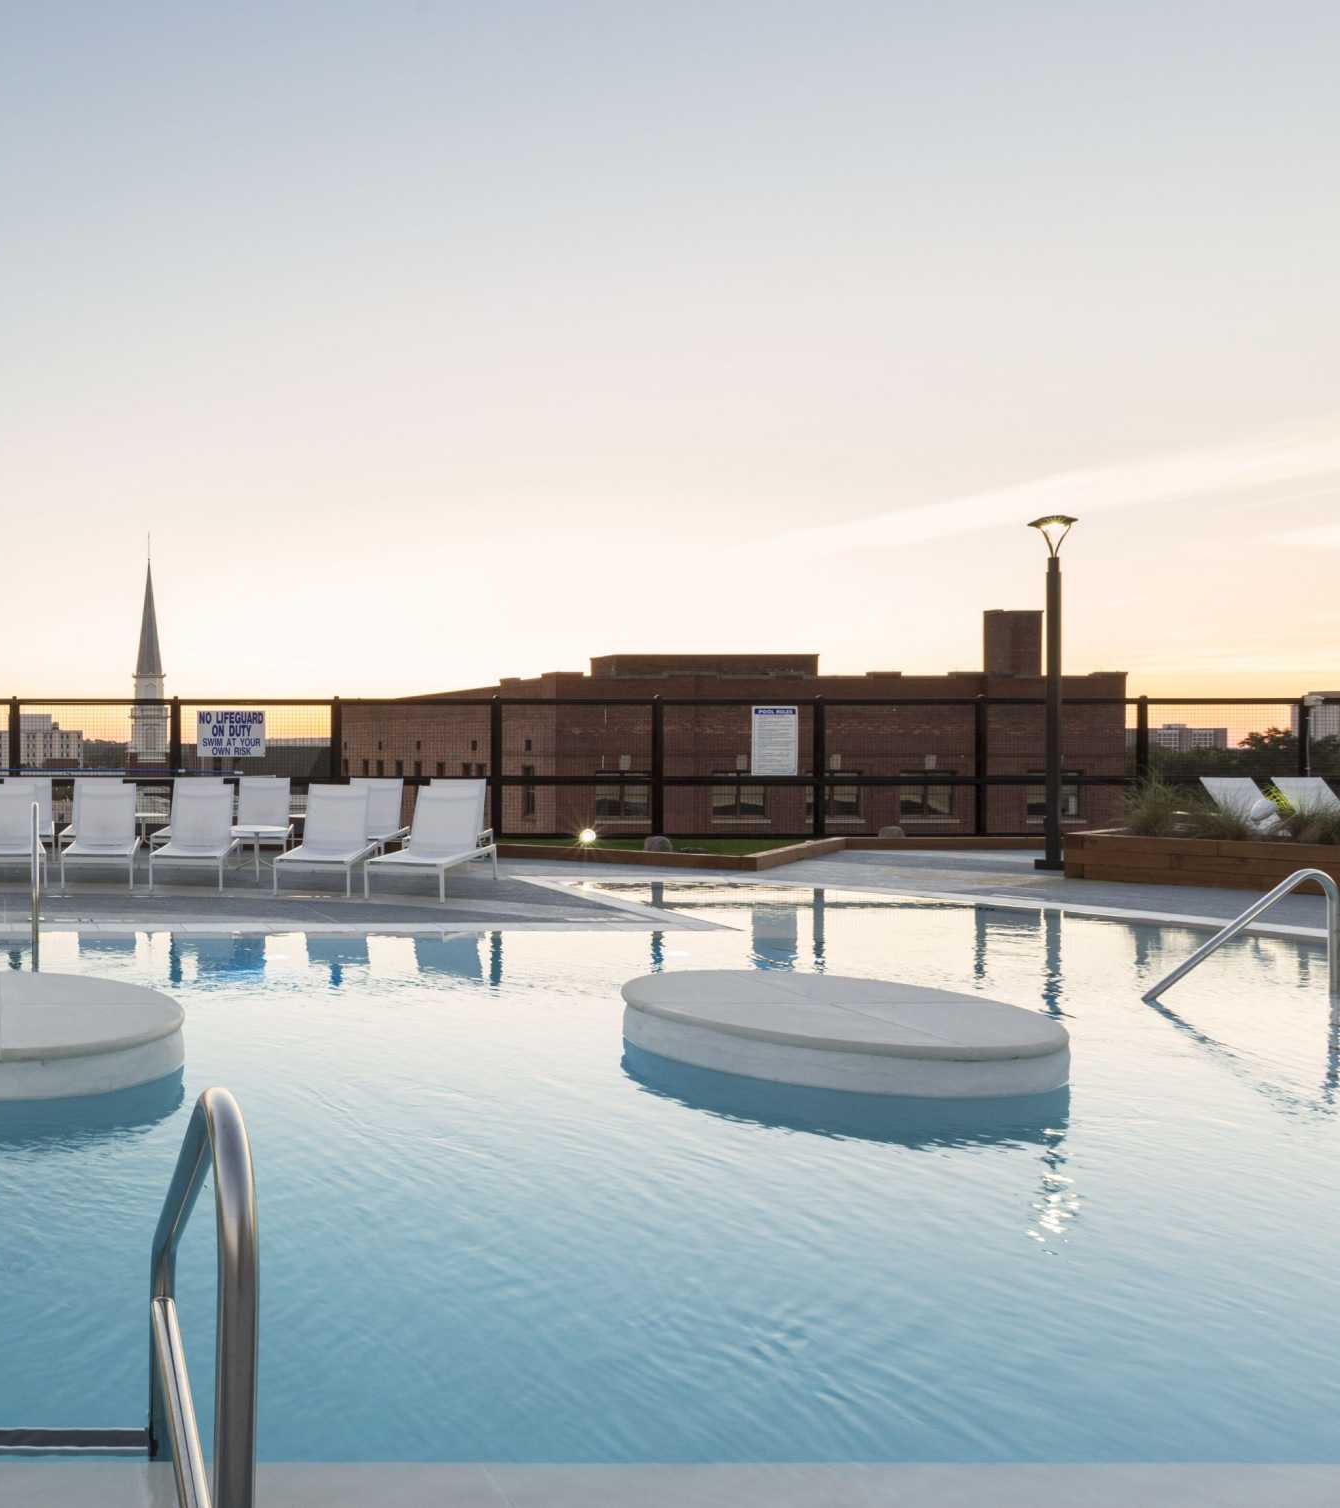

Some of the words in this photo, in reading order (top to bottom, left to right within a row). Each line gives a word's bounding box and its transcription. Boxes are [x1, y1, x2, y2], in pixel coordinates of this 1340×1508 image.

[199, 711, 212, 724] NO
[216, 711, 264, 724] LIFEGUARD
[211, 724, 225, 737] ON
[228, 724, 252, 737] DUTY
[202, 738, 223, 747] SWIM
[226, 738, 236, 747] AT
[239, 738, 261, 747] YOUR
[211, 746, 231, 756] OWN
[234, 746, 252, 756] RISK
